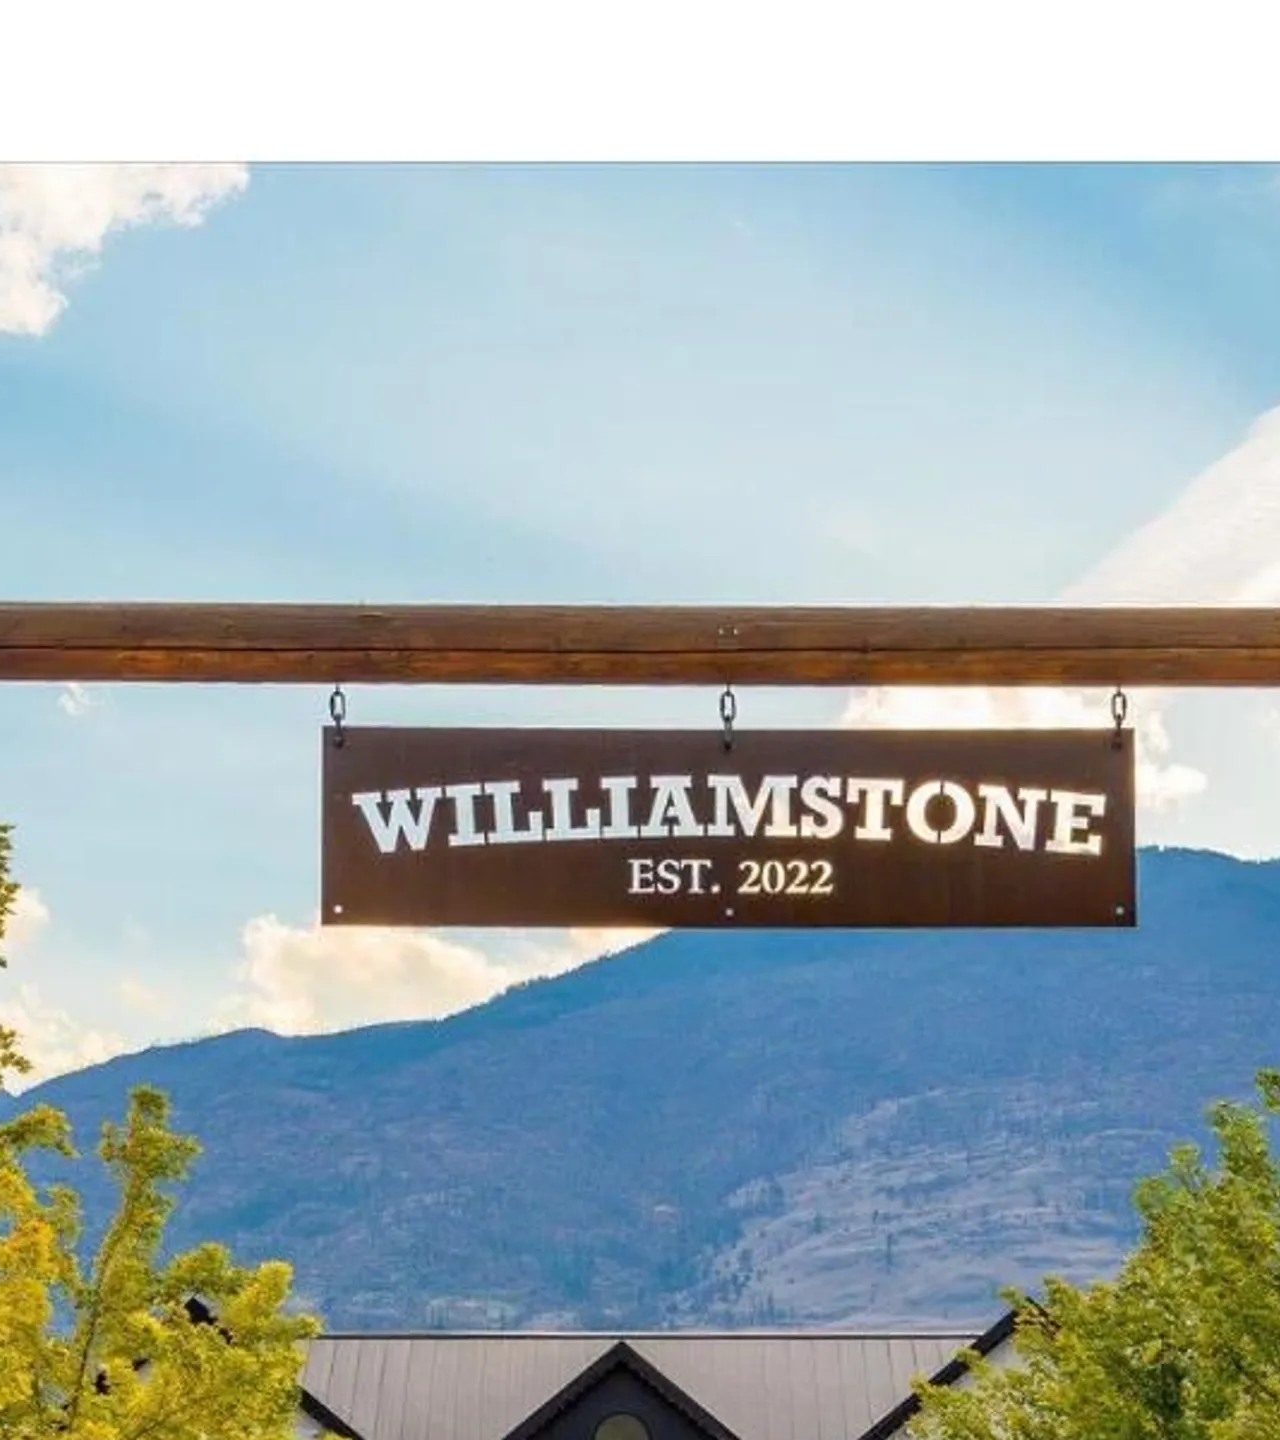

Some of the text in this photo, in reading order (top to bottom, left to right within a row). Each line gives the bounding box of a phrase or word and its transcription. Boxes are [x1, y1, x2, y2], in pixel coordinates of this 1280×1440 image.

[352, 774, 1107, 857] WILLIAMSTONE
[628, 859, 835, 896] EST. 2022
